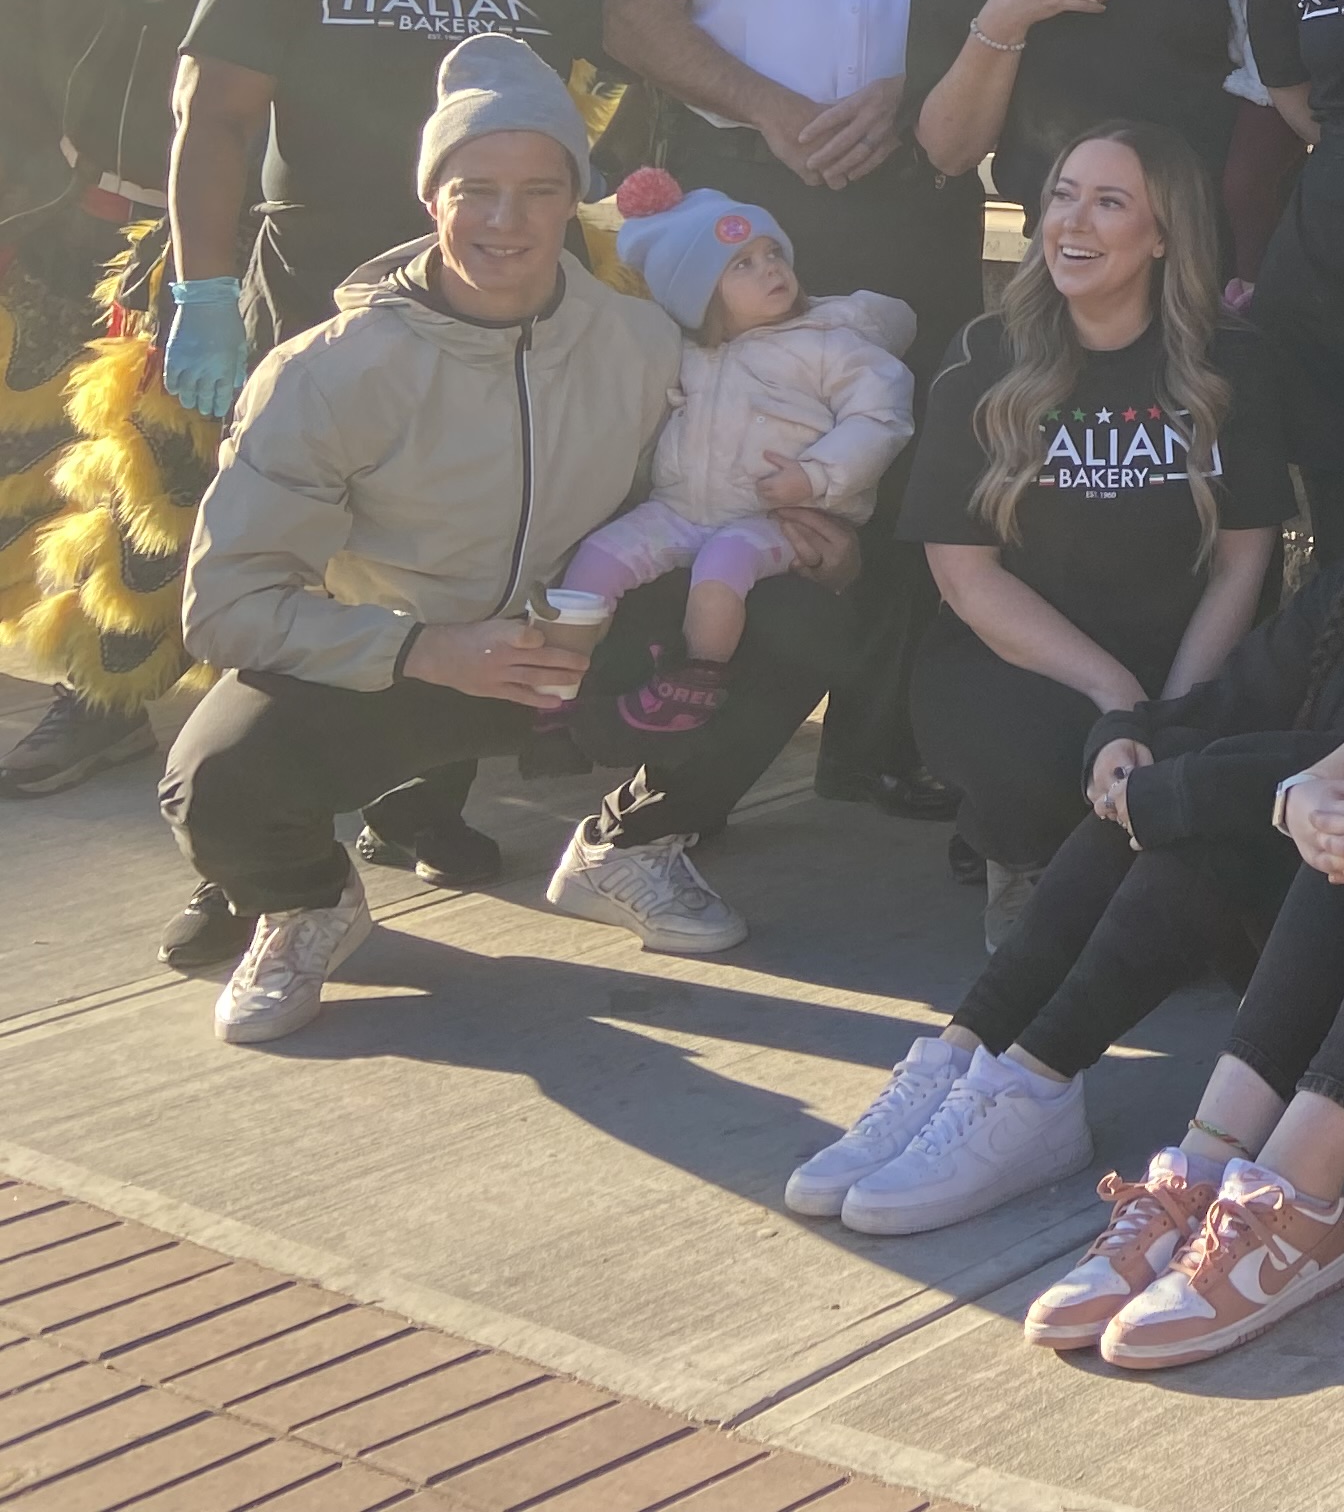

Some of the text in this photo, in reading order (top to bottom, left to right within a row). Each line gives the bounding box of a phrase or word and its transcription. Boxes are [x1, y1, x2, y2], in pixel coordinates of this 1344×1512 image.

[399, 15, 496, 34] BAKERY
[1058, 467, 1149, 488] BAKERY
[658, 682, 717, 707] OREL
